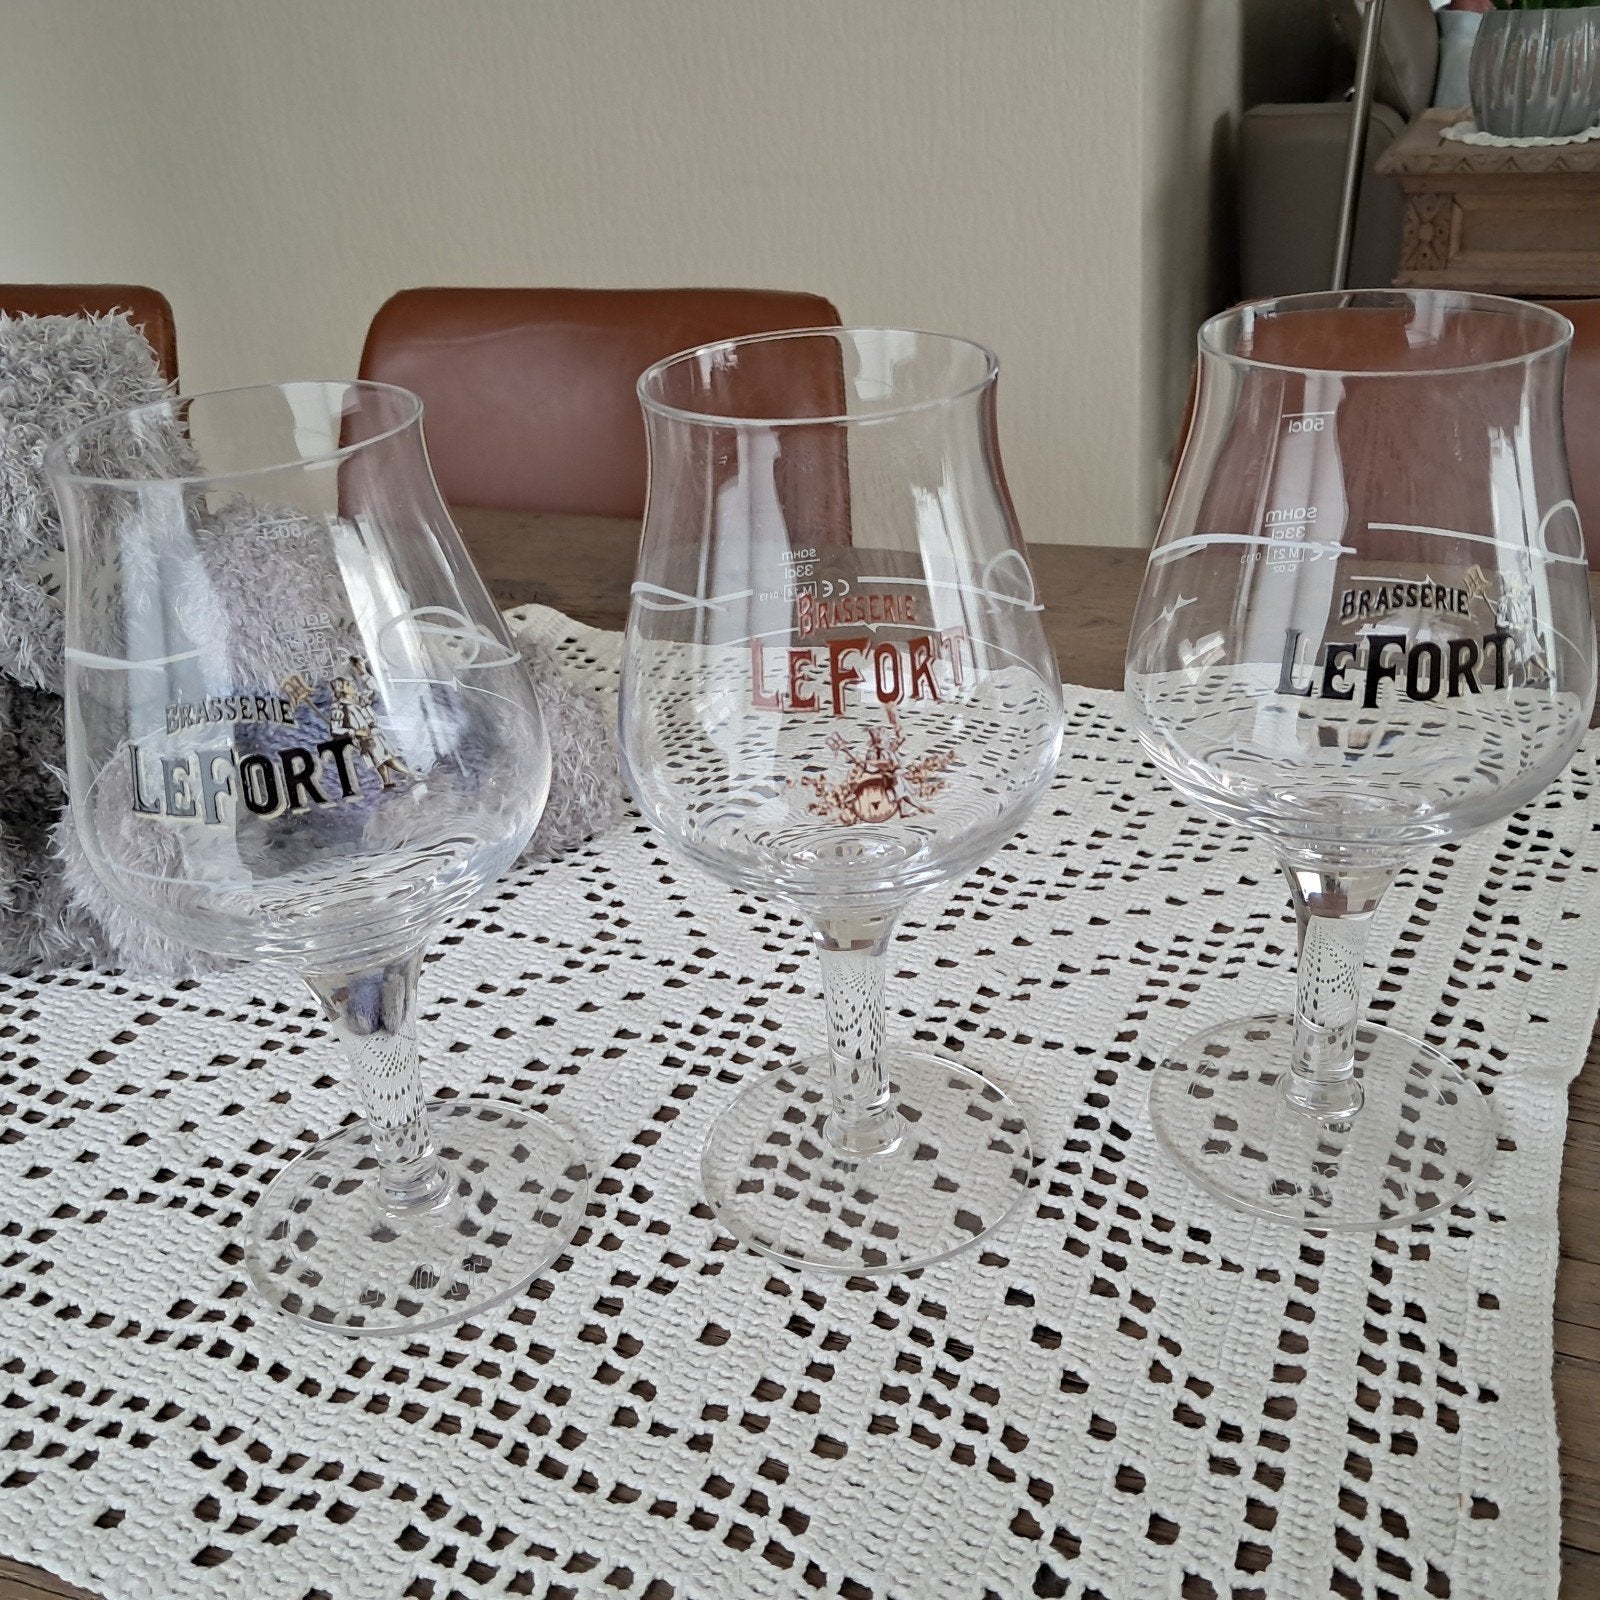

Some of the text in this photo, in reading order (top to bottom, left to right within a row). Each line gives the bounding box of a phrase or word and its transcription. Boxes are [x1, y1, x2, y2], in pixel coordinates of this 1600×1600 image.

[797, 593, 916, 638] BRASSERIE
[1339, 583, 1472, 624] BRASSERIE
[165, 696, 297, 735] BRASSERIE
